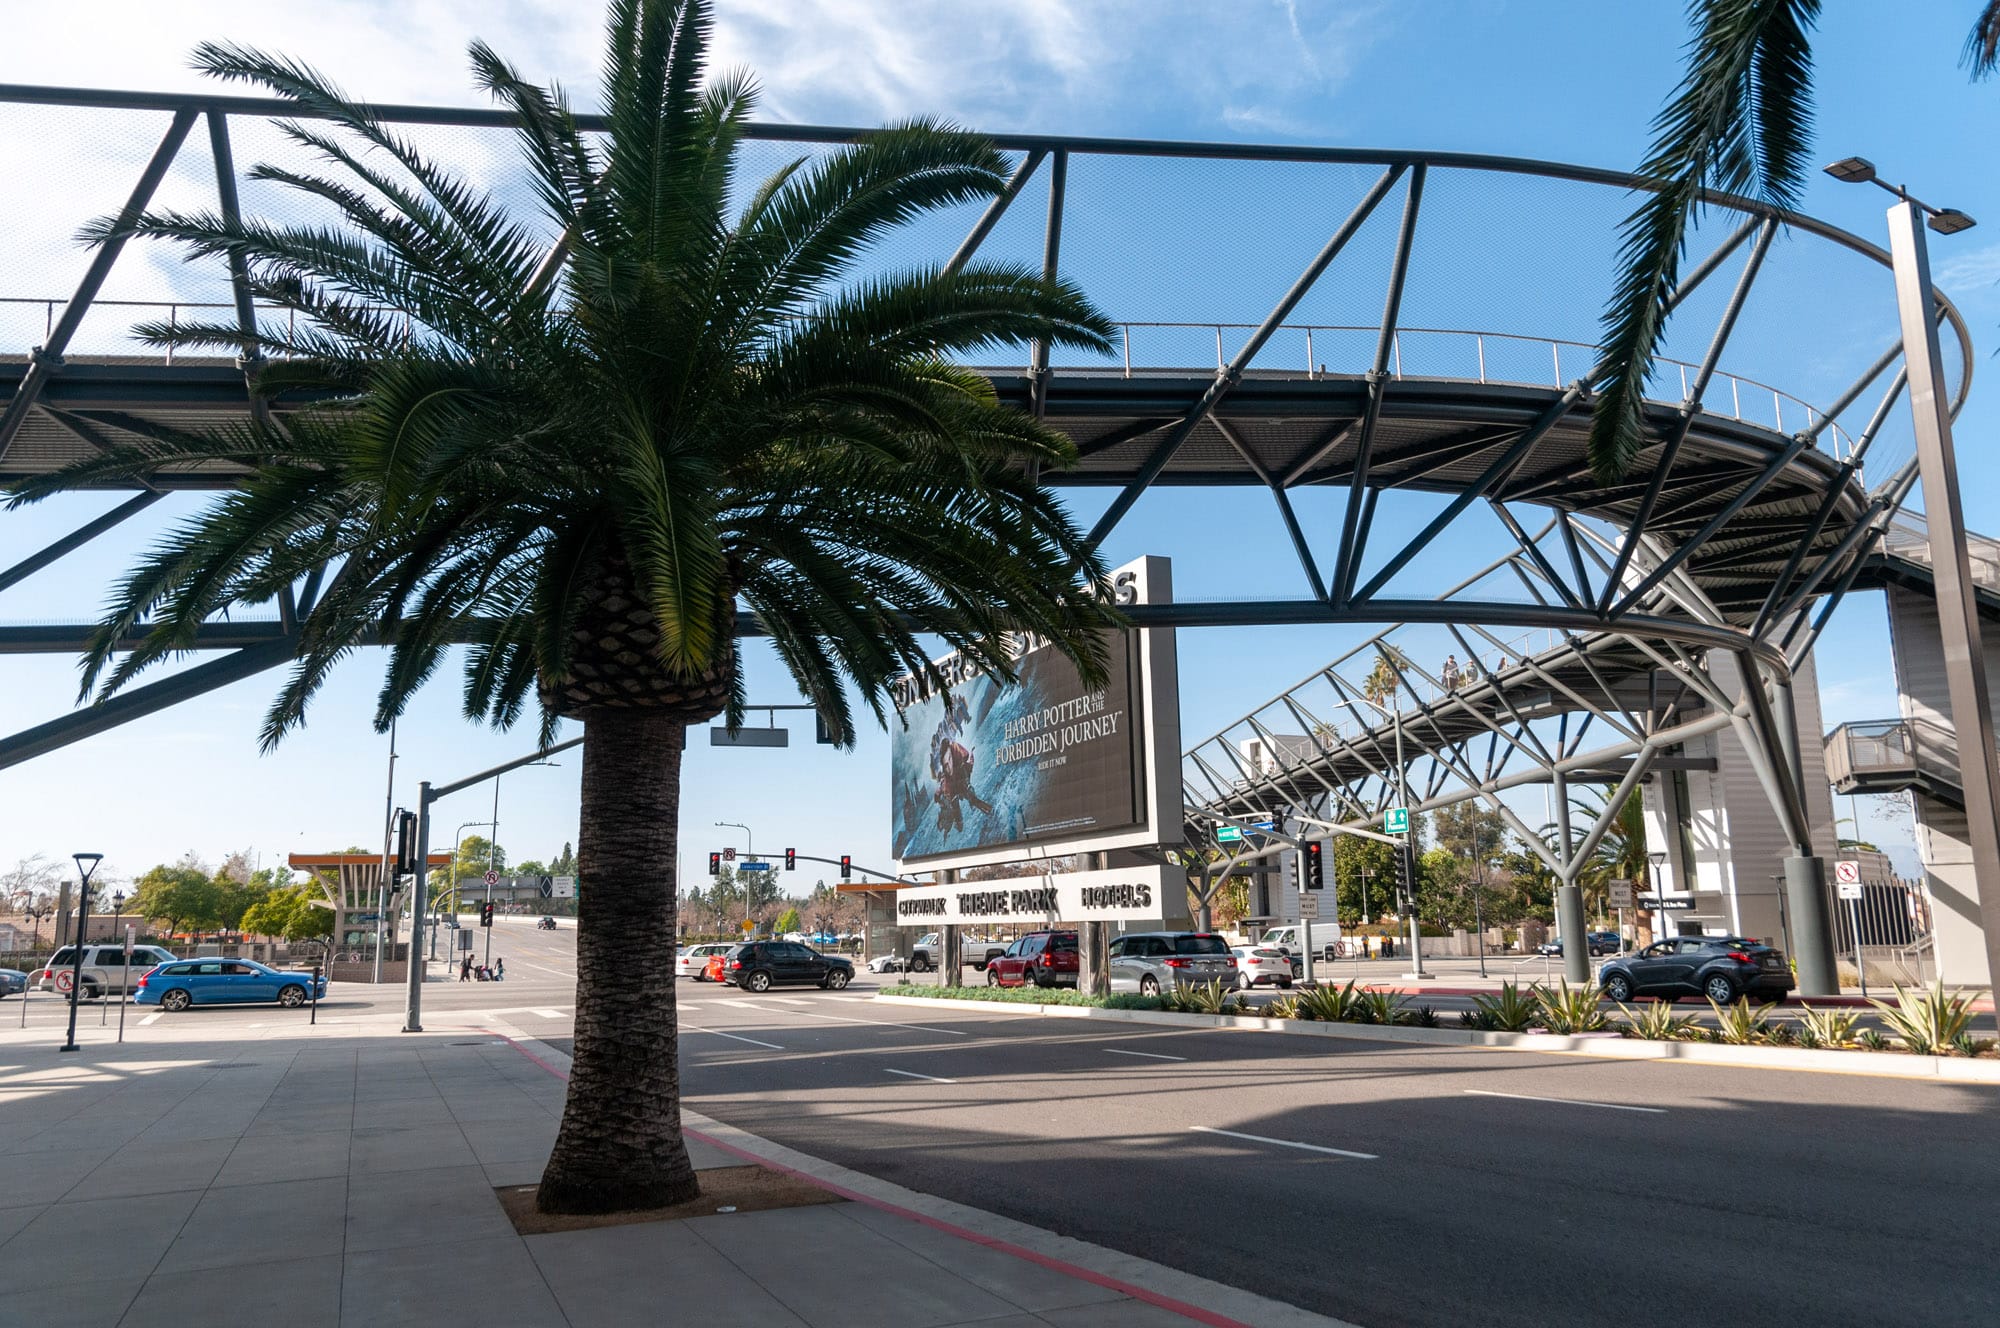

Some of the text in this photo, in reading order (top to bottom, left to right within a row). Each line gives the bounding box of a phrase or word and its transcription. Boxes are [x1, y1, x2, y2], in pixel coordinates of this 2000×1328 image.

[1004, 694, 1092, 741] HARRY POTTER
[1091, 700, 1105, 713] THE
[995, 731, 1058, 767] FORBIDDEN
[957, 890, 1009, 916] THEME
[1010, 887, 1059, 914] PARK
[1080, 884, 1152, 909] HOTELS
